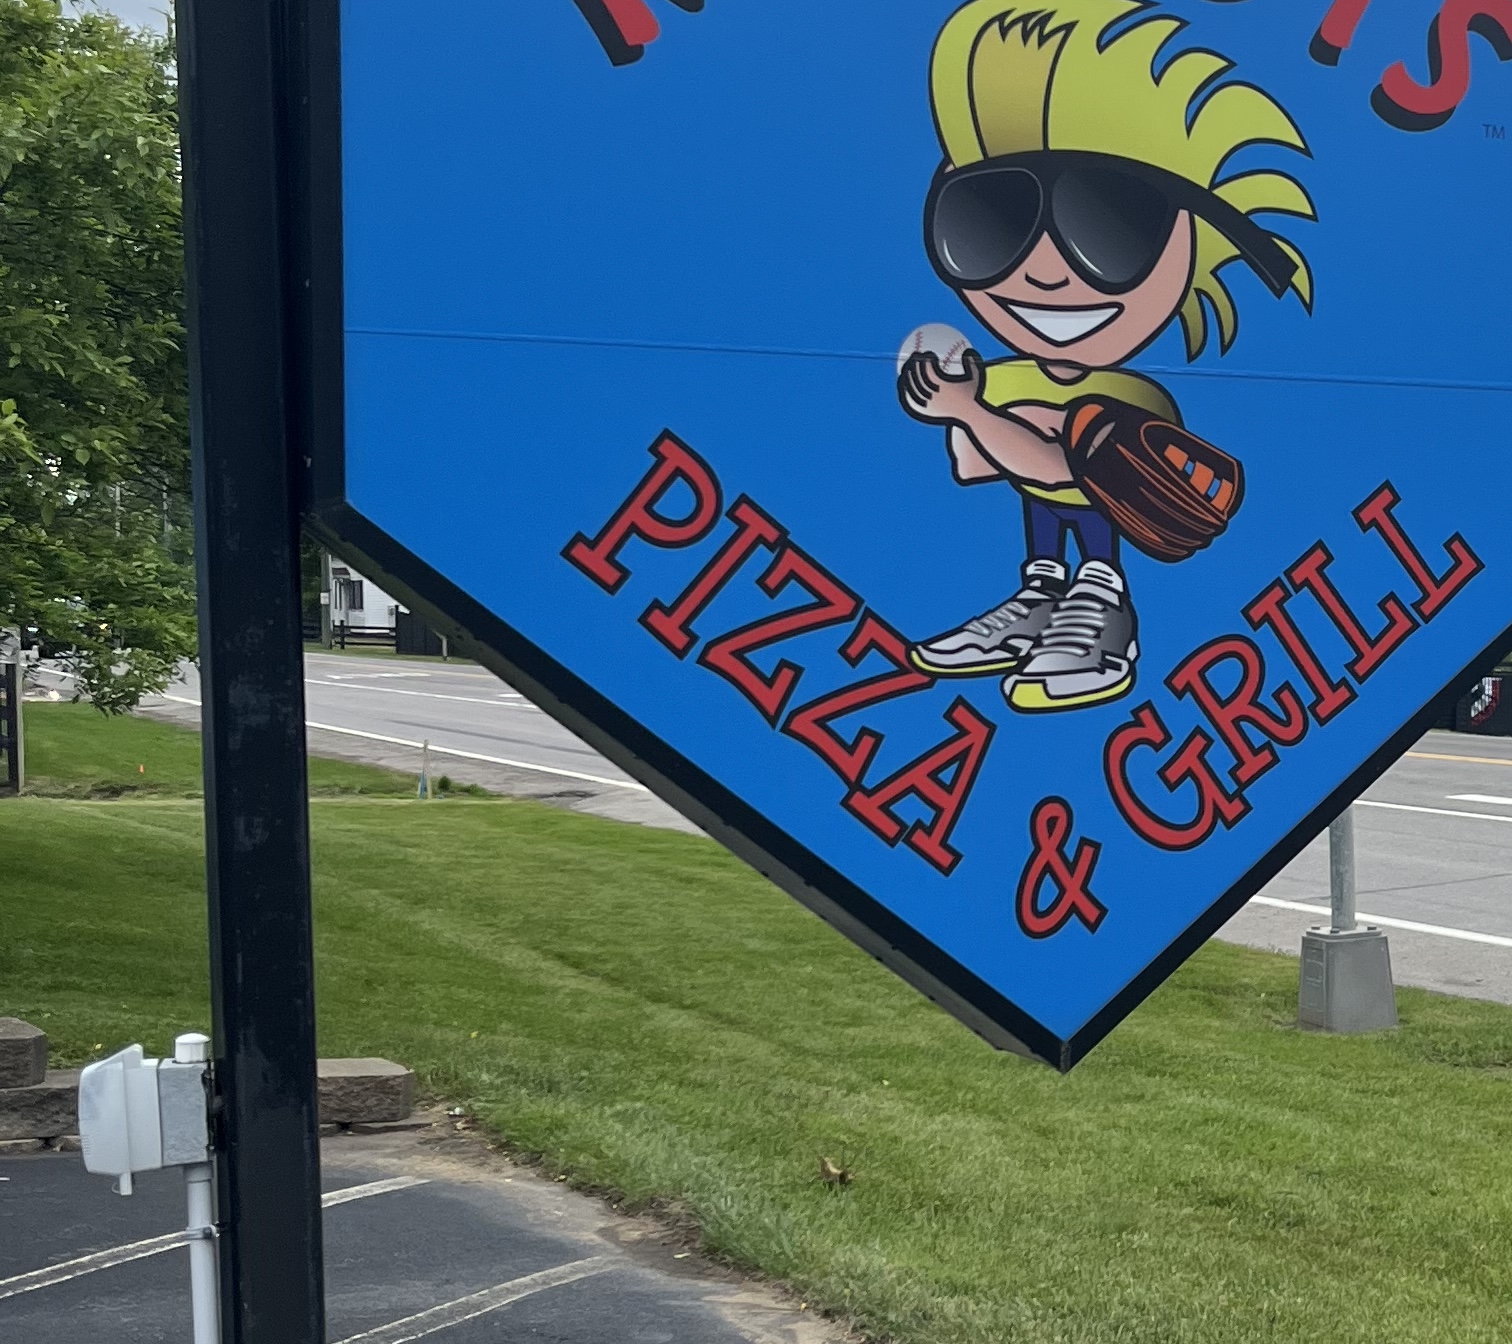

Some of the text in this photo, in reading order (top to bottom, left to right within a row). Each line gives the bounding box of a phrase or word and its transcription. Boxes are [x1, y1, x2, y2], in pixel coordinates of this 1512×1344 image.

[1482, 123, 1506, 140] TM
[561, 430, 1485, 938] PIZZA & GRILL
